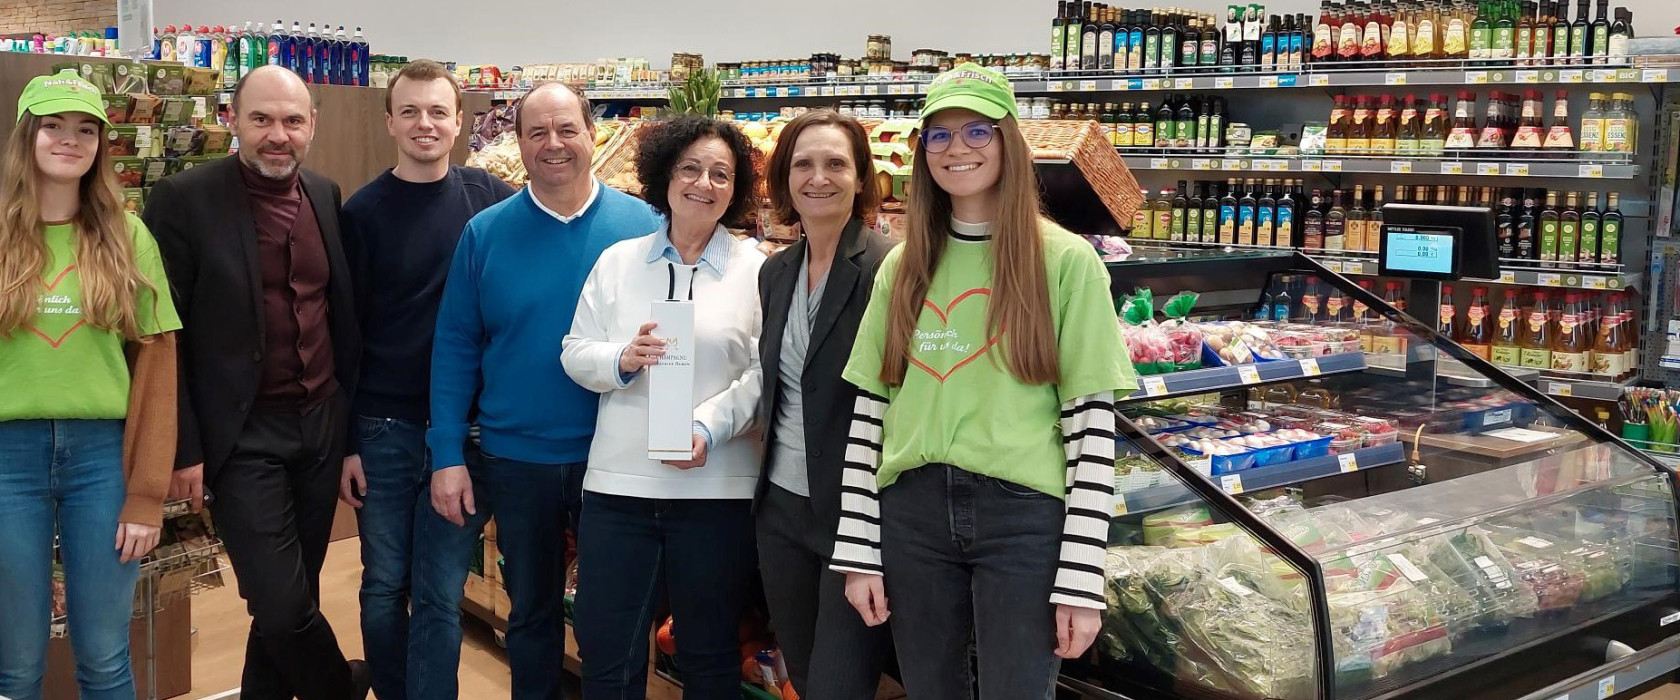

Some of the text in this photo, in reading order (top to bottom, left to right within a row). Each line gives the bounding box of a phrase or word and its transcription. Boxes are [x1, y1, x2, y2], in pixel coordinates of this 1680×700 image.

[64, 305, 82, 314] da
[914, 328, 958, 340] Persönch
[919, 341, 937, 352] für
